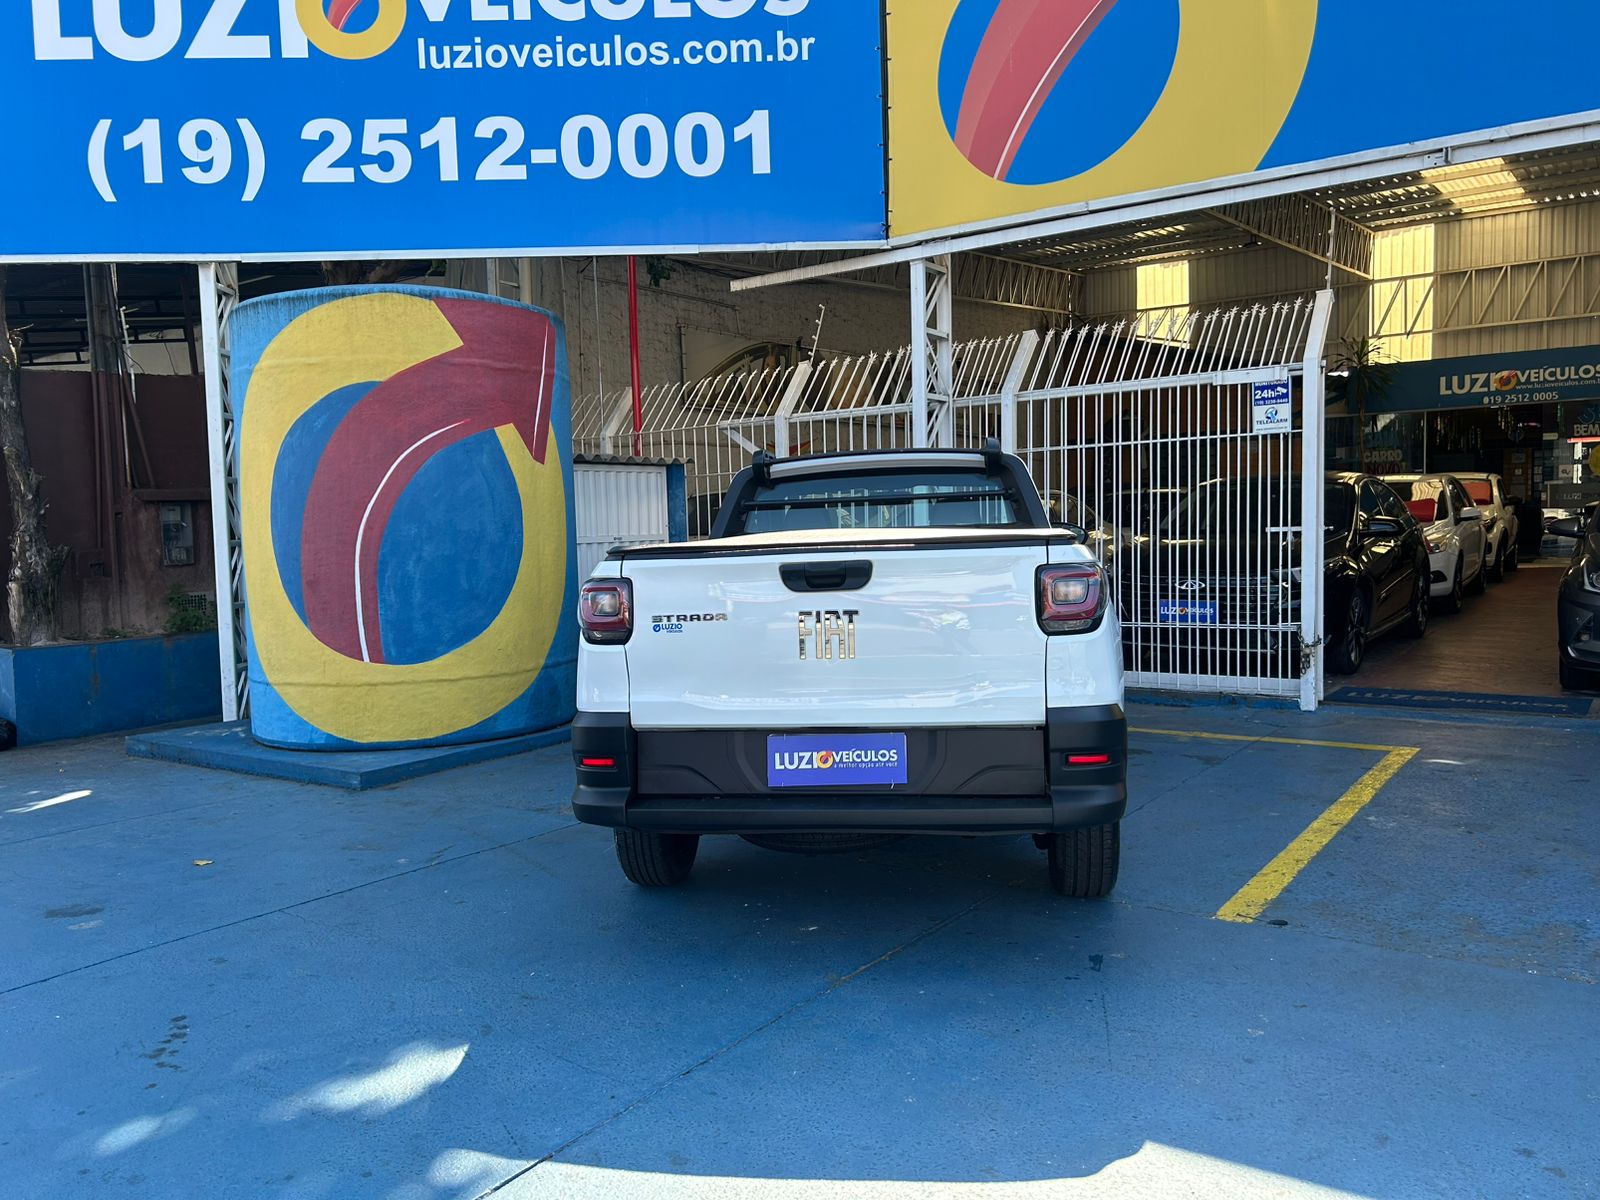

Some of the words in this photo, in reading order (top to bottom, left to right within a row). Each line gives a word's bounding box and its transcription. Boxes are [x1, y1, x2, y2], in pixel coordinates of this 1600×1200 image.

[417, 31, 815, 70] luzioveiculos.com.br
[87, 118, 266, 202] (19)
[300, 109, 771, 183] 2512-0001
[1439, 370, 1517, 395] LUZIO
[1255, 388, 1275, 399] 24h
[1504, 393, 1530, 403] 2512
[1533, 391, 1559, 401] 0005
[652, 613, 728, 623] STRADA
[661, 623, 683, 631] LUZIO
[798, 609, 859, 660] FIAT
[775, 751, 833, 769] LUZIO
[832, 748, 898, 763] VEÍCULOS
